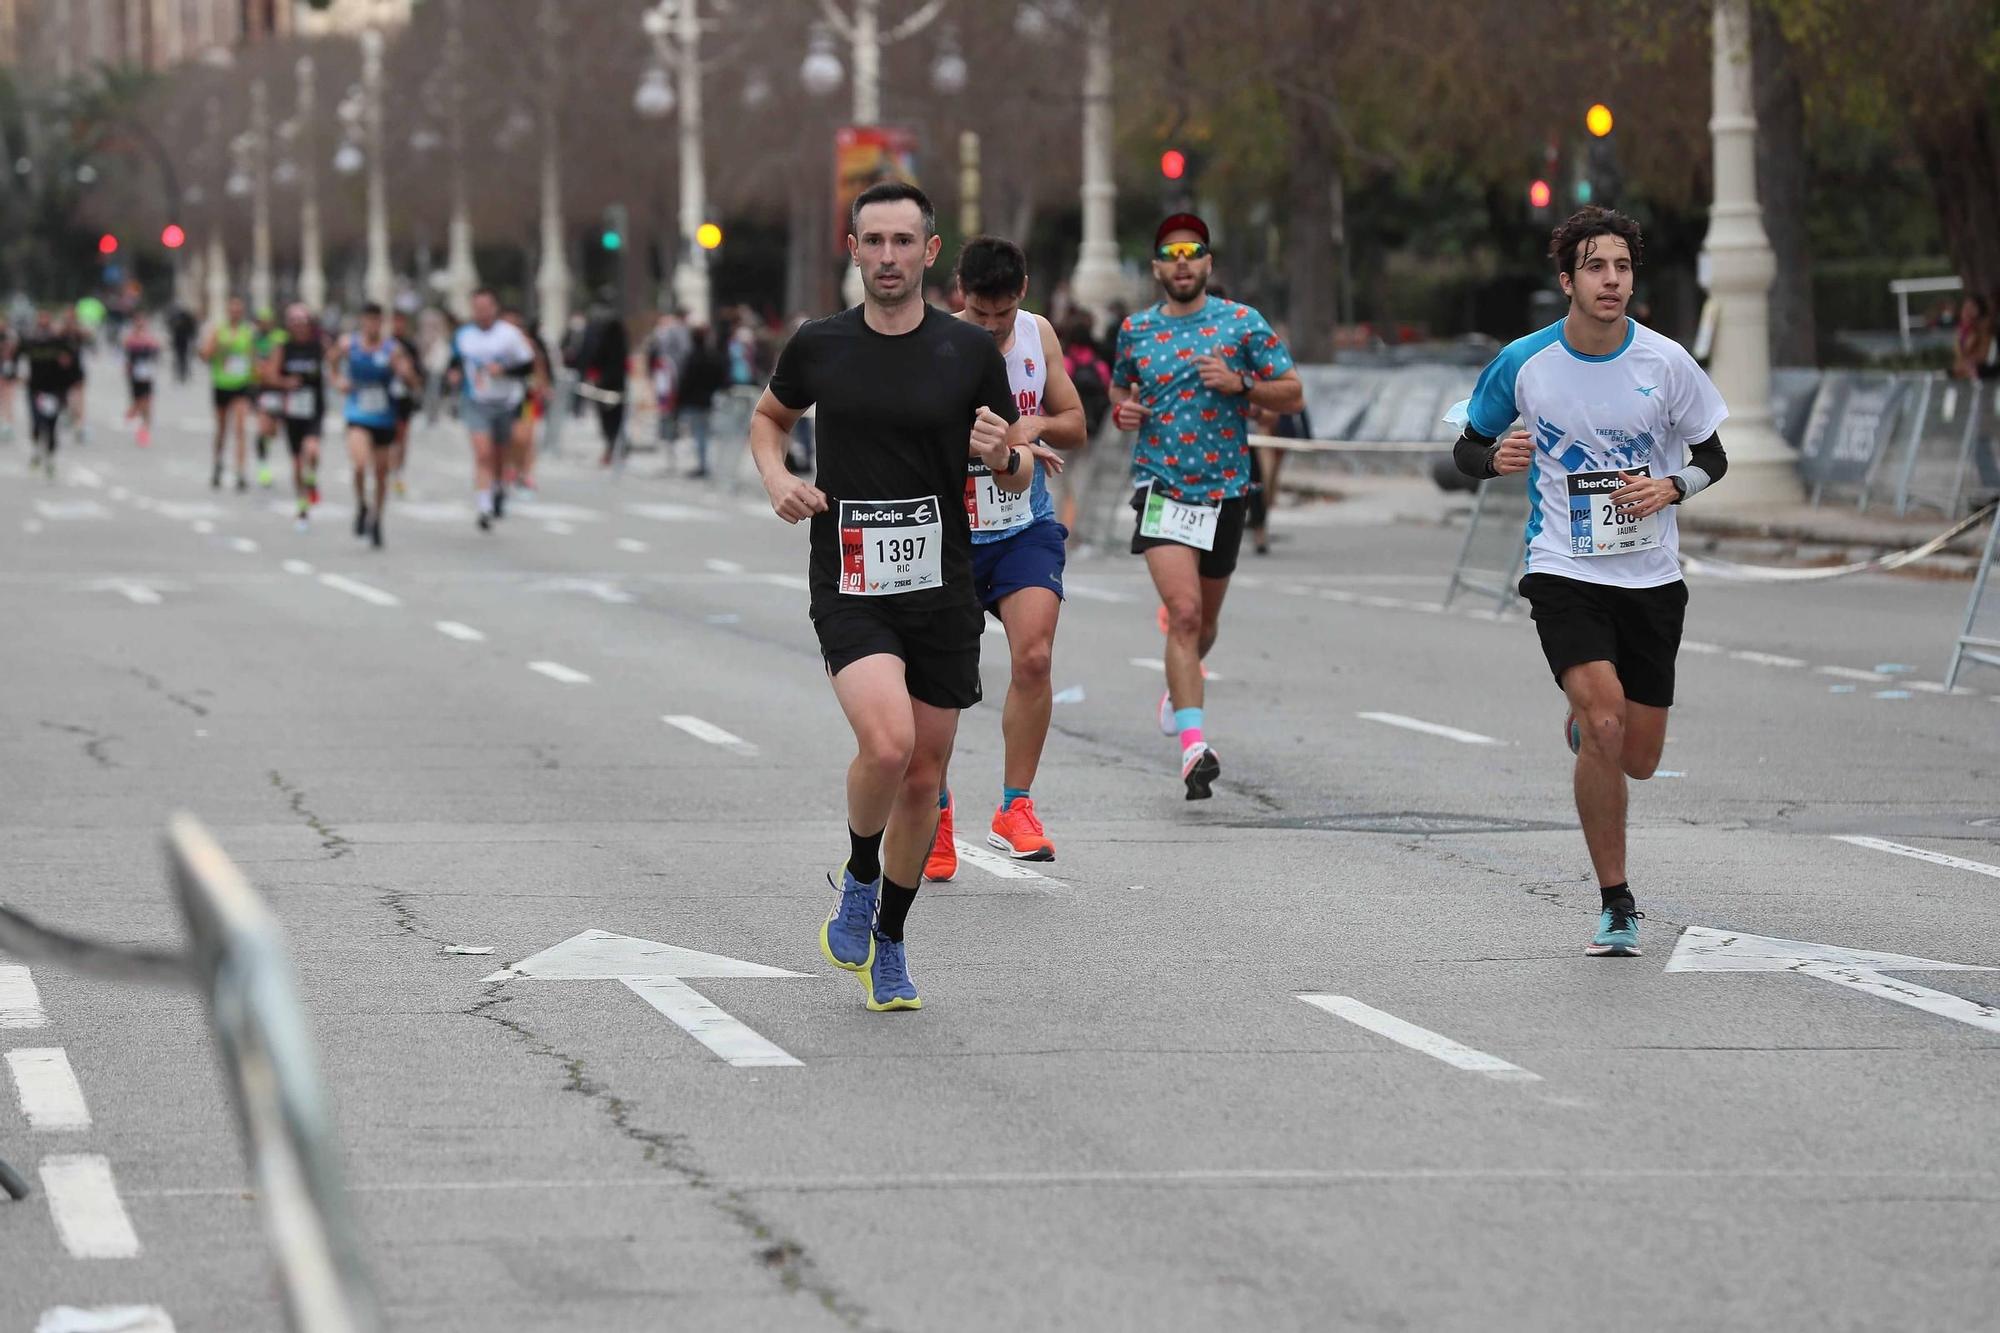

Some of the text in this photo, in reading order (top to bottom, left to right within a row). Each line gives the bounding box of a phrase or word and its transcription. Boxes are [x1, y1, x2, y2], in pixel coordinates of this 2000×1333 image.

[1595, 428, 1625, 436] THERE'S
[851, 509, 904, 524] iberCaja
[1171, 504, 1206, 528] 7751
[1616, 525, 1638, 536] JAUME
[1578, 535, 1592, 549] 02
[875, 536, 927, 564] 1397
[896, 563, 911, 574] RIC
[849, 572, 862, 587] 01
